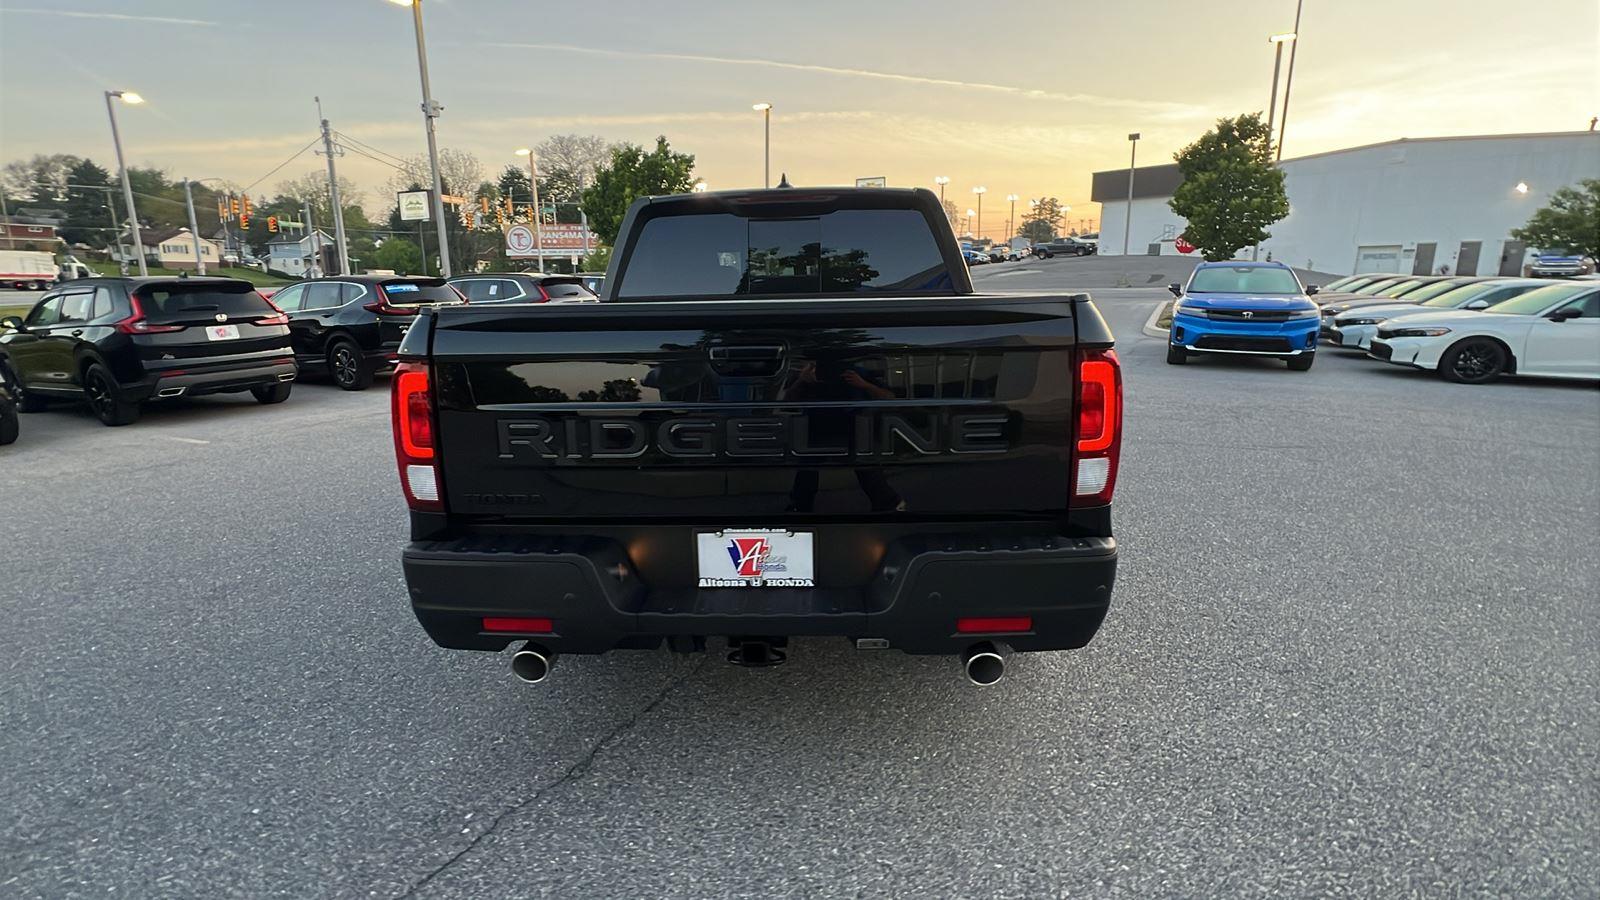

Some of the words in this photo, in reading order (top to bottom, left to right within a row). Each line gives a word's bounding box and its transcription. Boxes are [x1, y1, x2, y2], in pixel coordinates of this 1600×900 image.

[496, 417, 1010, 459] RIDGELINE
[698, 578, 747, 587] Altoona
[766, 579, 815, 587] HONDA
